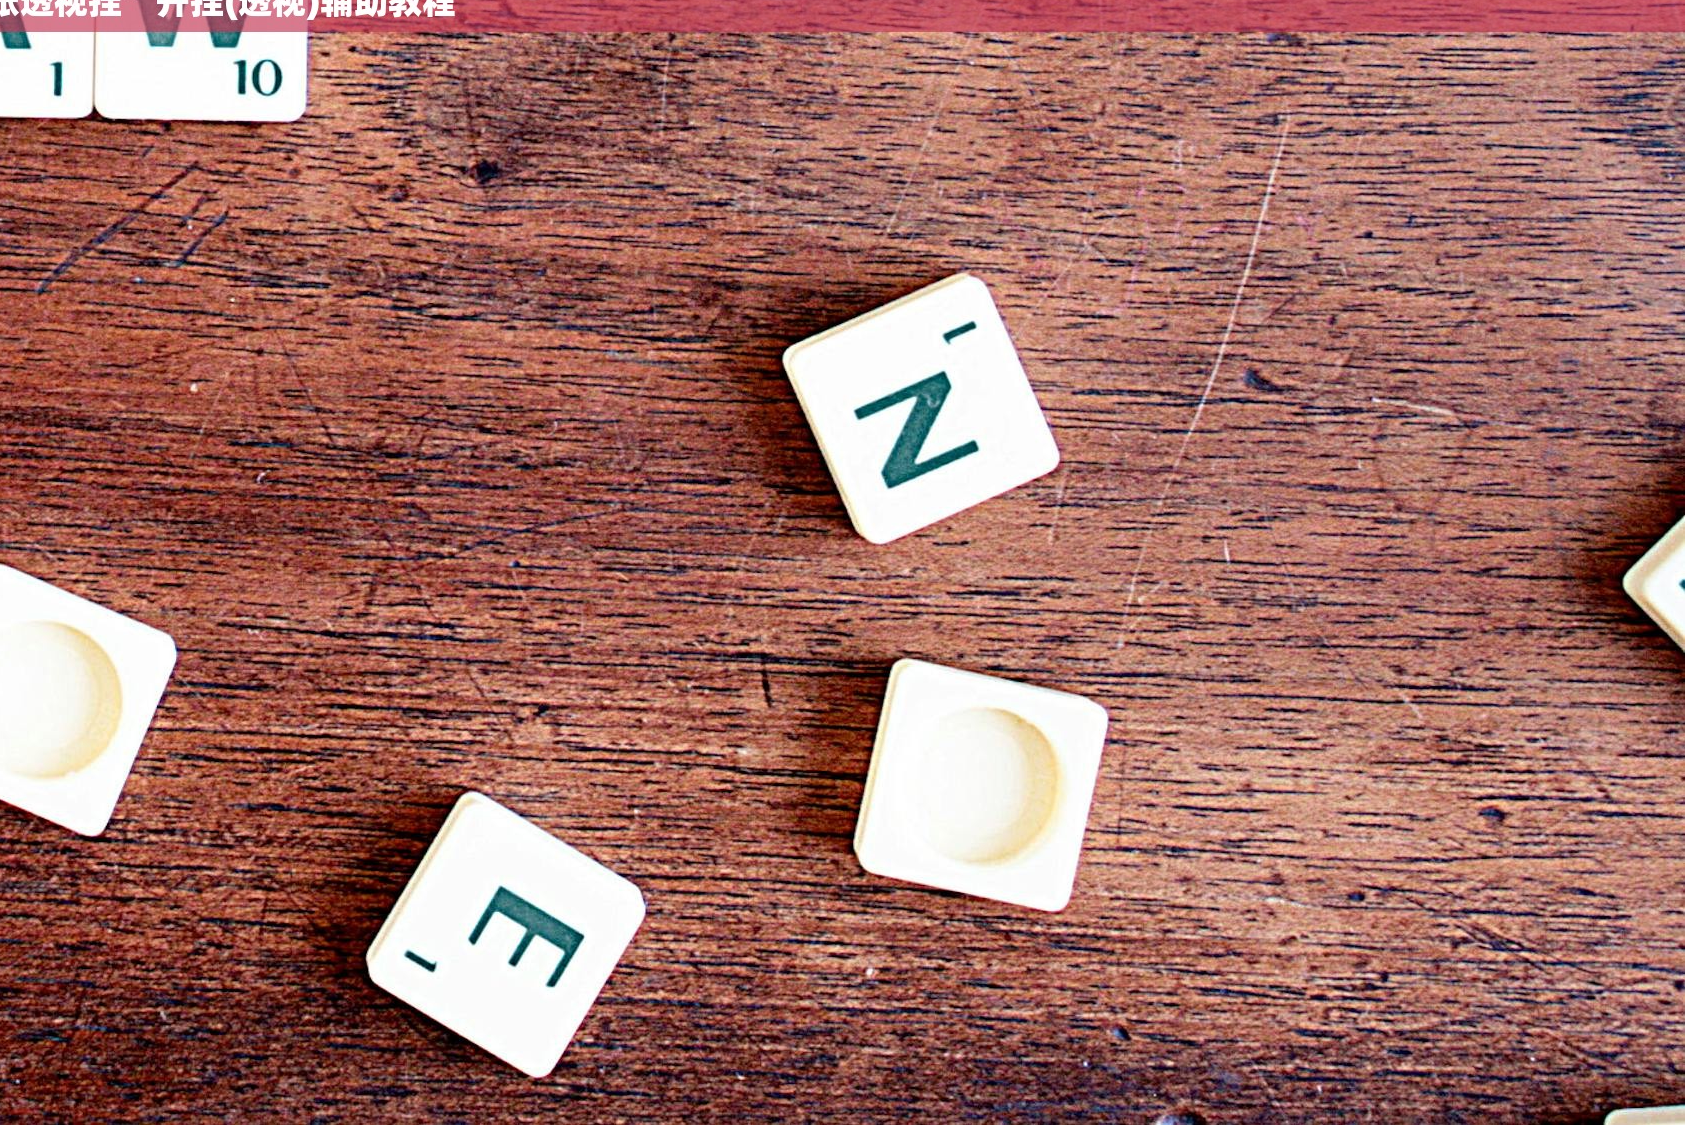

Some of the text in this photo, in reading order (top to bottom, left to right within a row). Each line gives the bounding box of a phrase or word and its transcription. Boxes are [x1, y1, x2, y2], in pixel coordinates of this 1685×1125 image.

[49, 60, 64, 98] 1
[232, 58, 285, 98] 10
[941, 320, 978, 345] 1
[854, 370, 979, 489] N
[468, 886, 585, 988] E
[403, 949, 438, 974] 1
